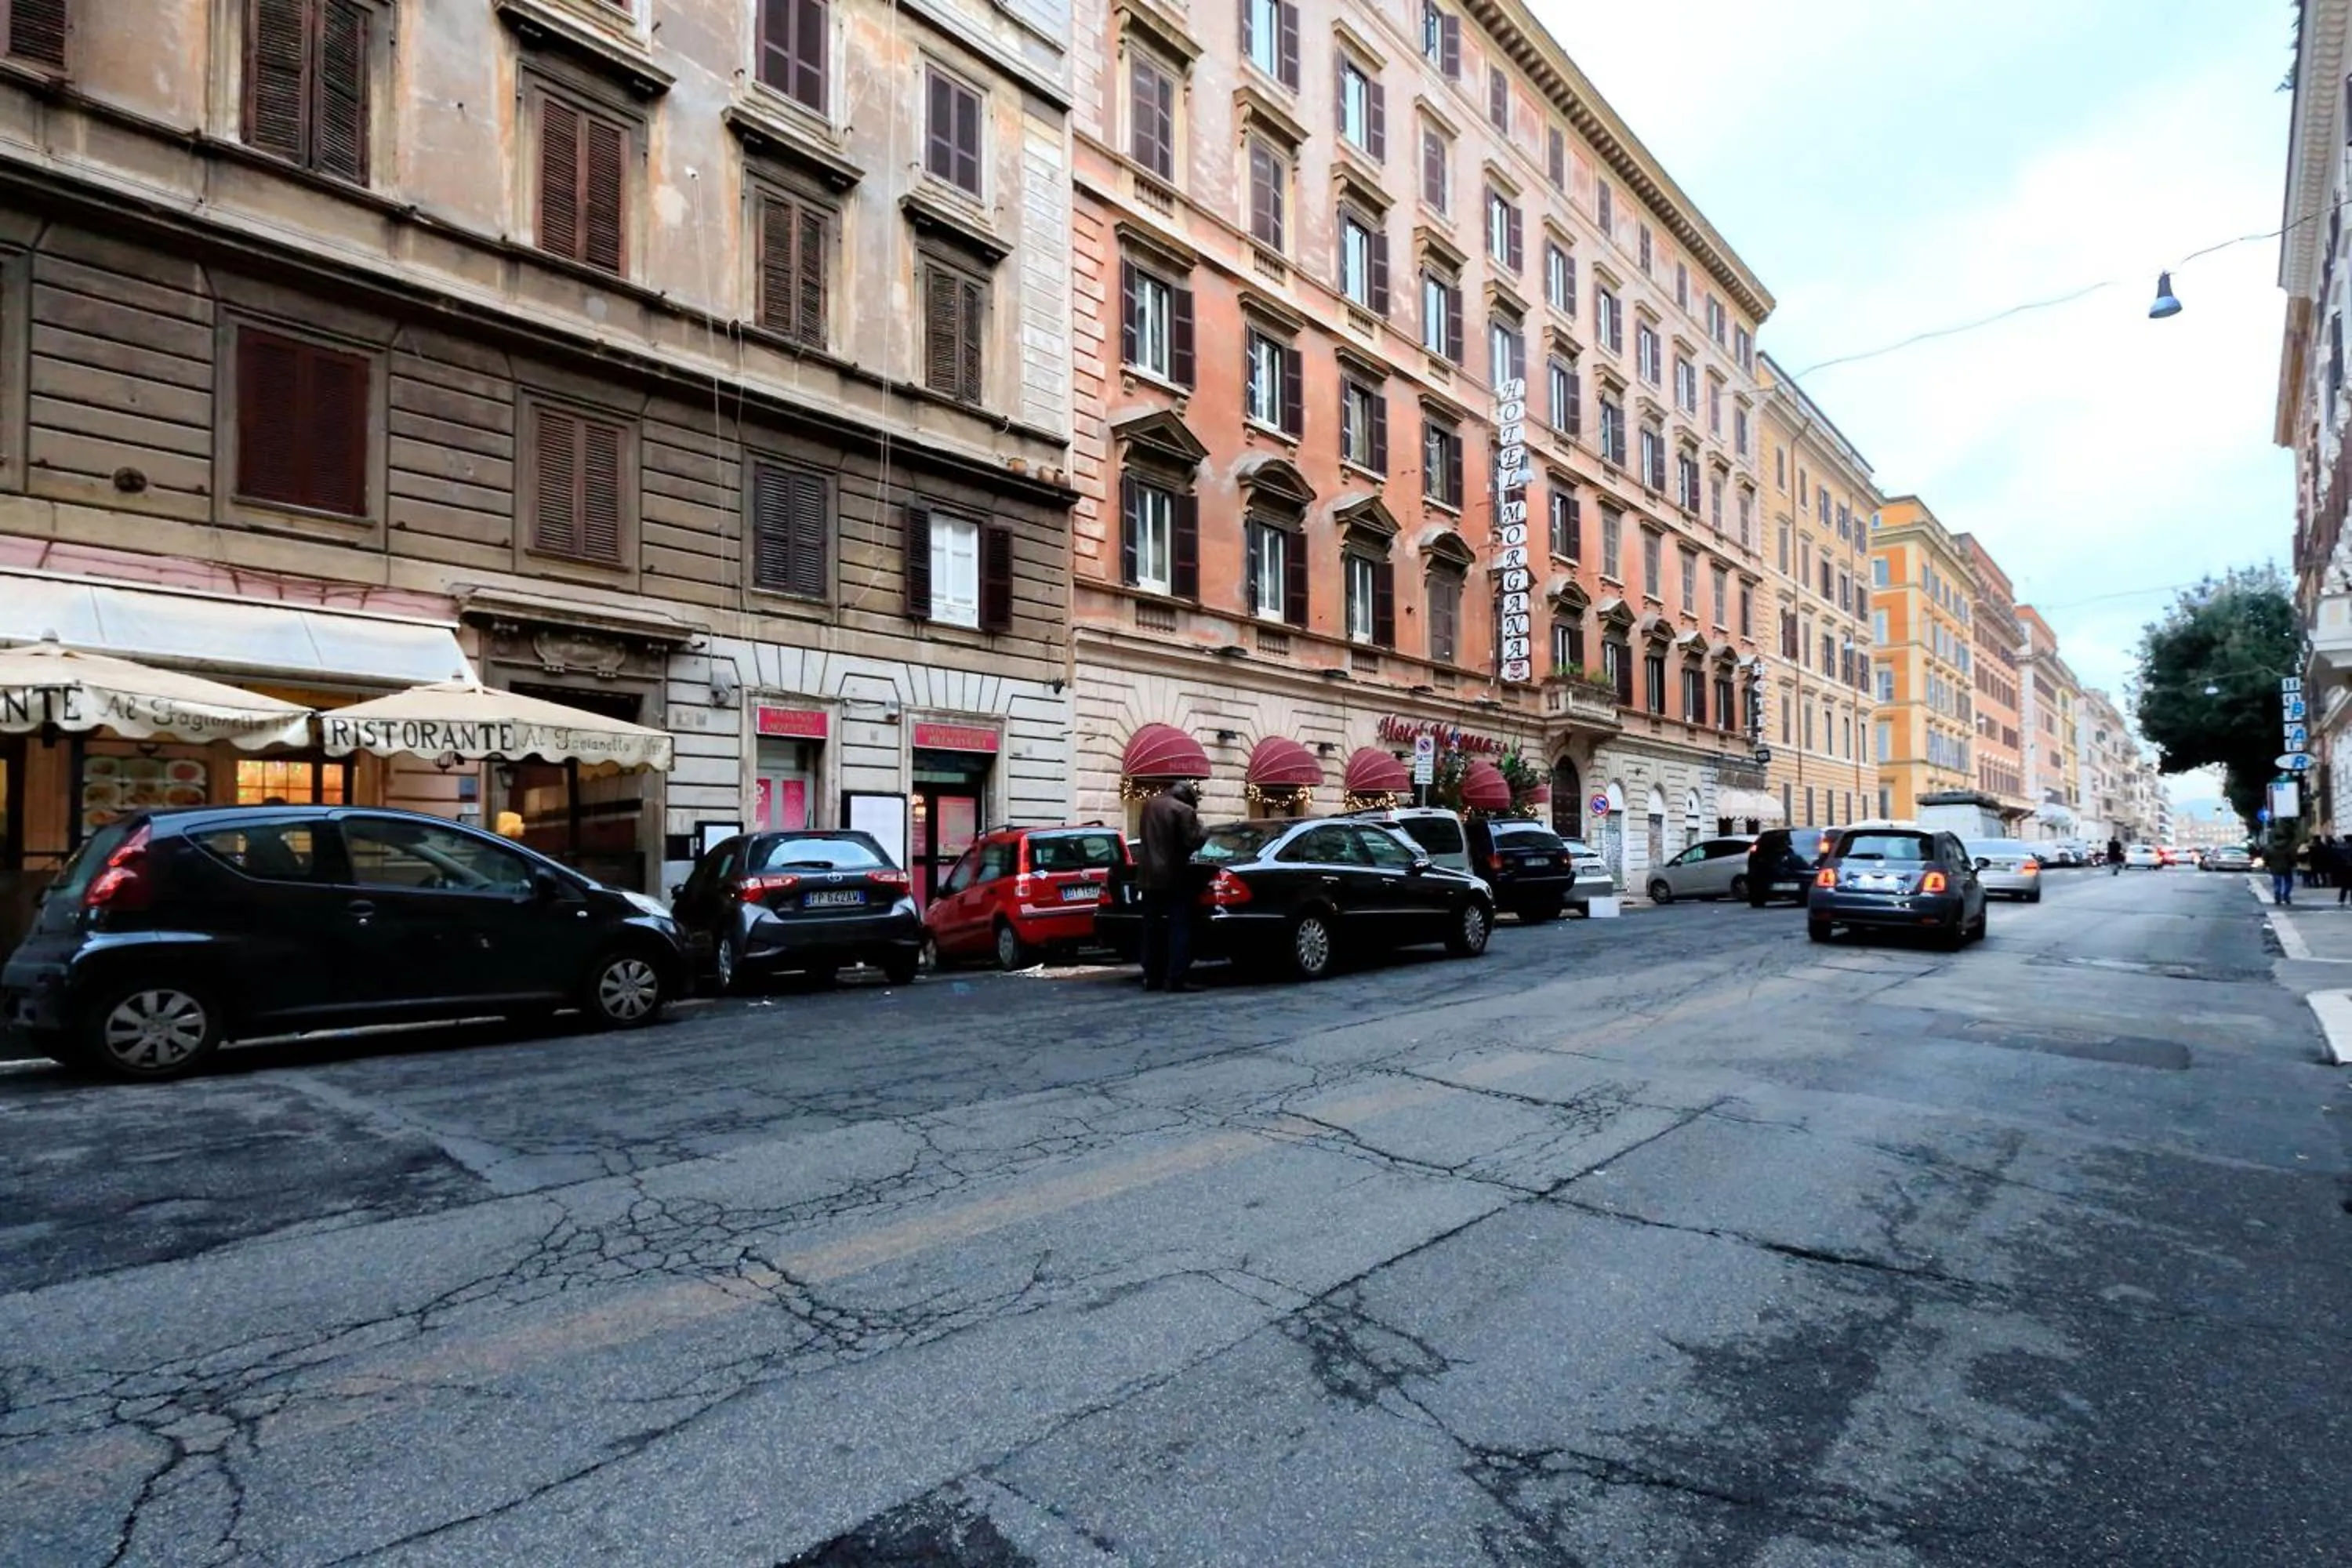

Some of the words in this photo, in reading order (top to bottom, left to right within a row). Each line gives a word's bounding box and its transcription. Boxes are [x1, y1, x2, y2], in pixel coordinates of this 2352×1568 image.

[1503, 379, 1519, 488] HOTEL
[1503, 502, 1523, 658] MORGANA
[0, 687, 82, 723] NTE
[332, 719, 513, 751] RISTORANTE
[2292, 701, 2307, 768] BAR
